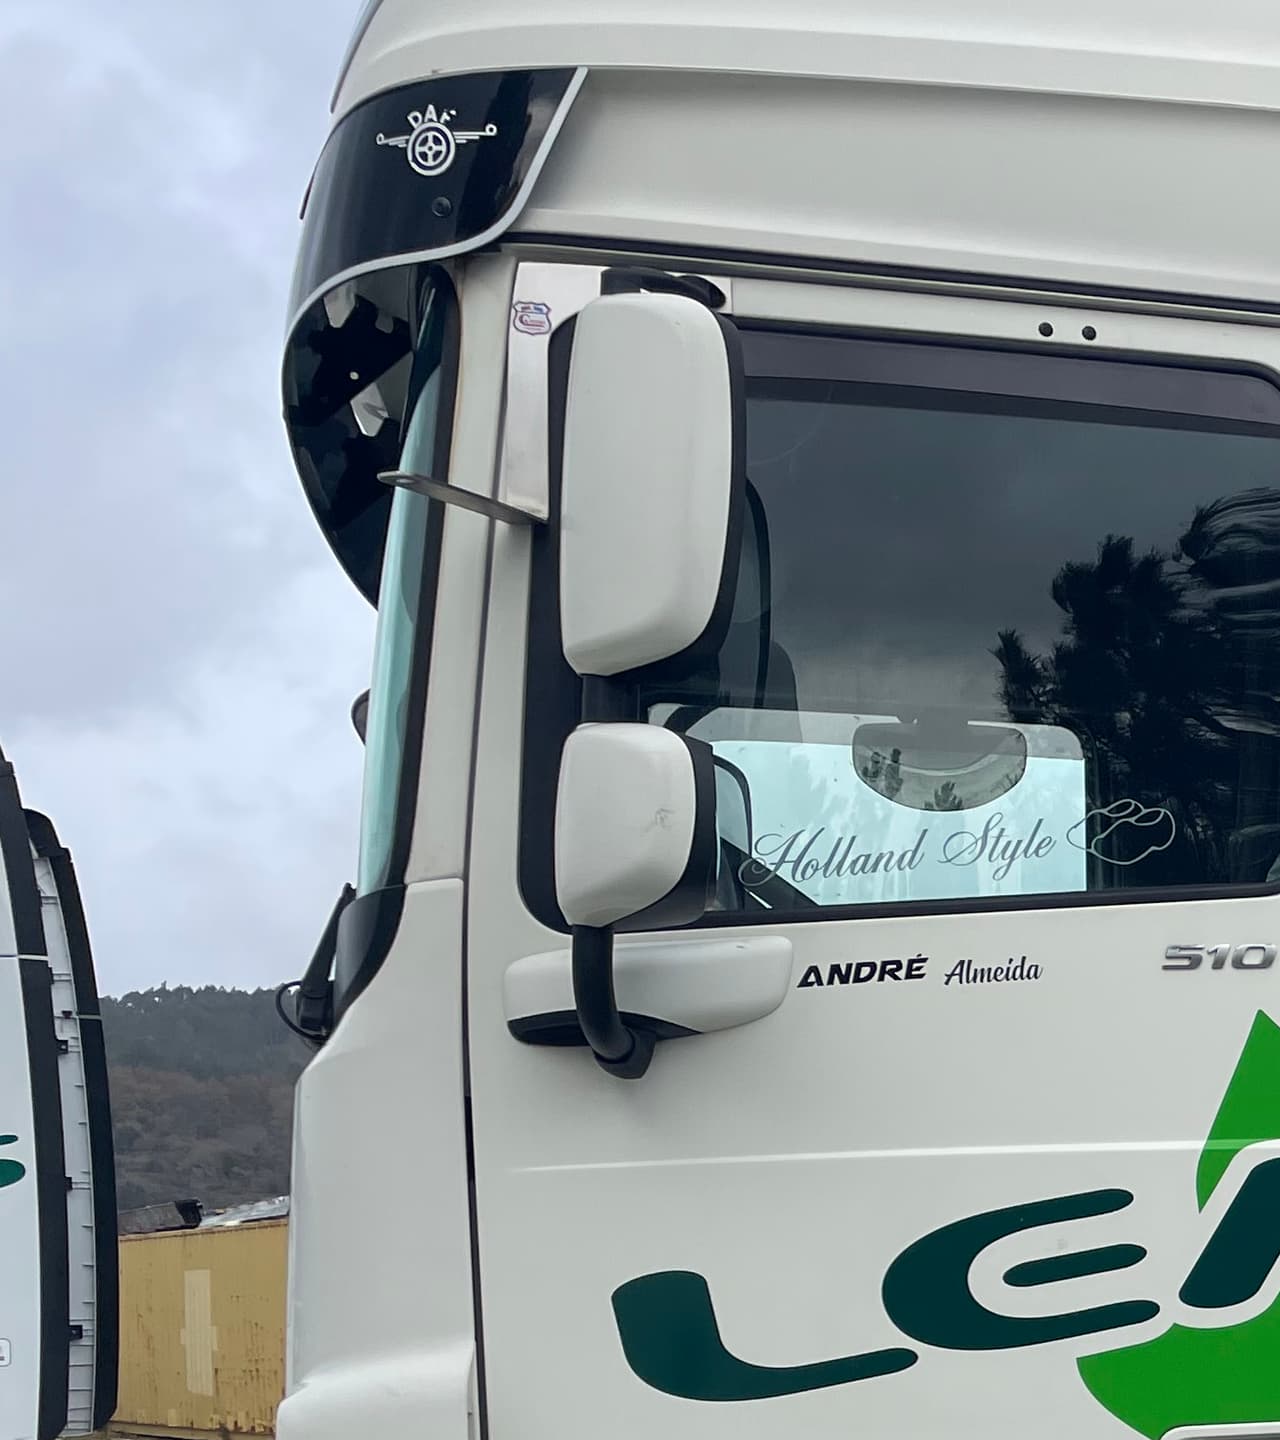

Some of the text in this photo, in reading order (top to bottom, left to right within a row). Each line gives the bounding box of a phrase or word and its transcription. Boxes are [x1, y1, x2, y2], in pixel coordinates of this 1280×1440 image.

[738, 811, 1057, 887] Holland Style
[797, 954, 1043, 989] ANDRÉ Almeida
[1161, 943, 1278, 971] 510
